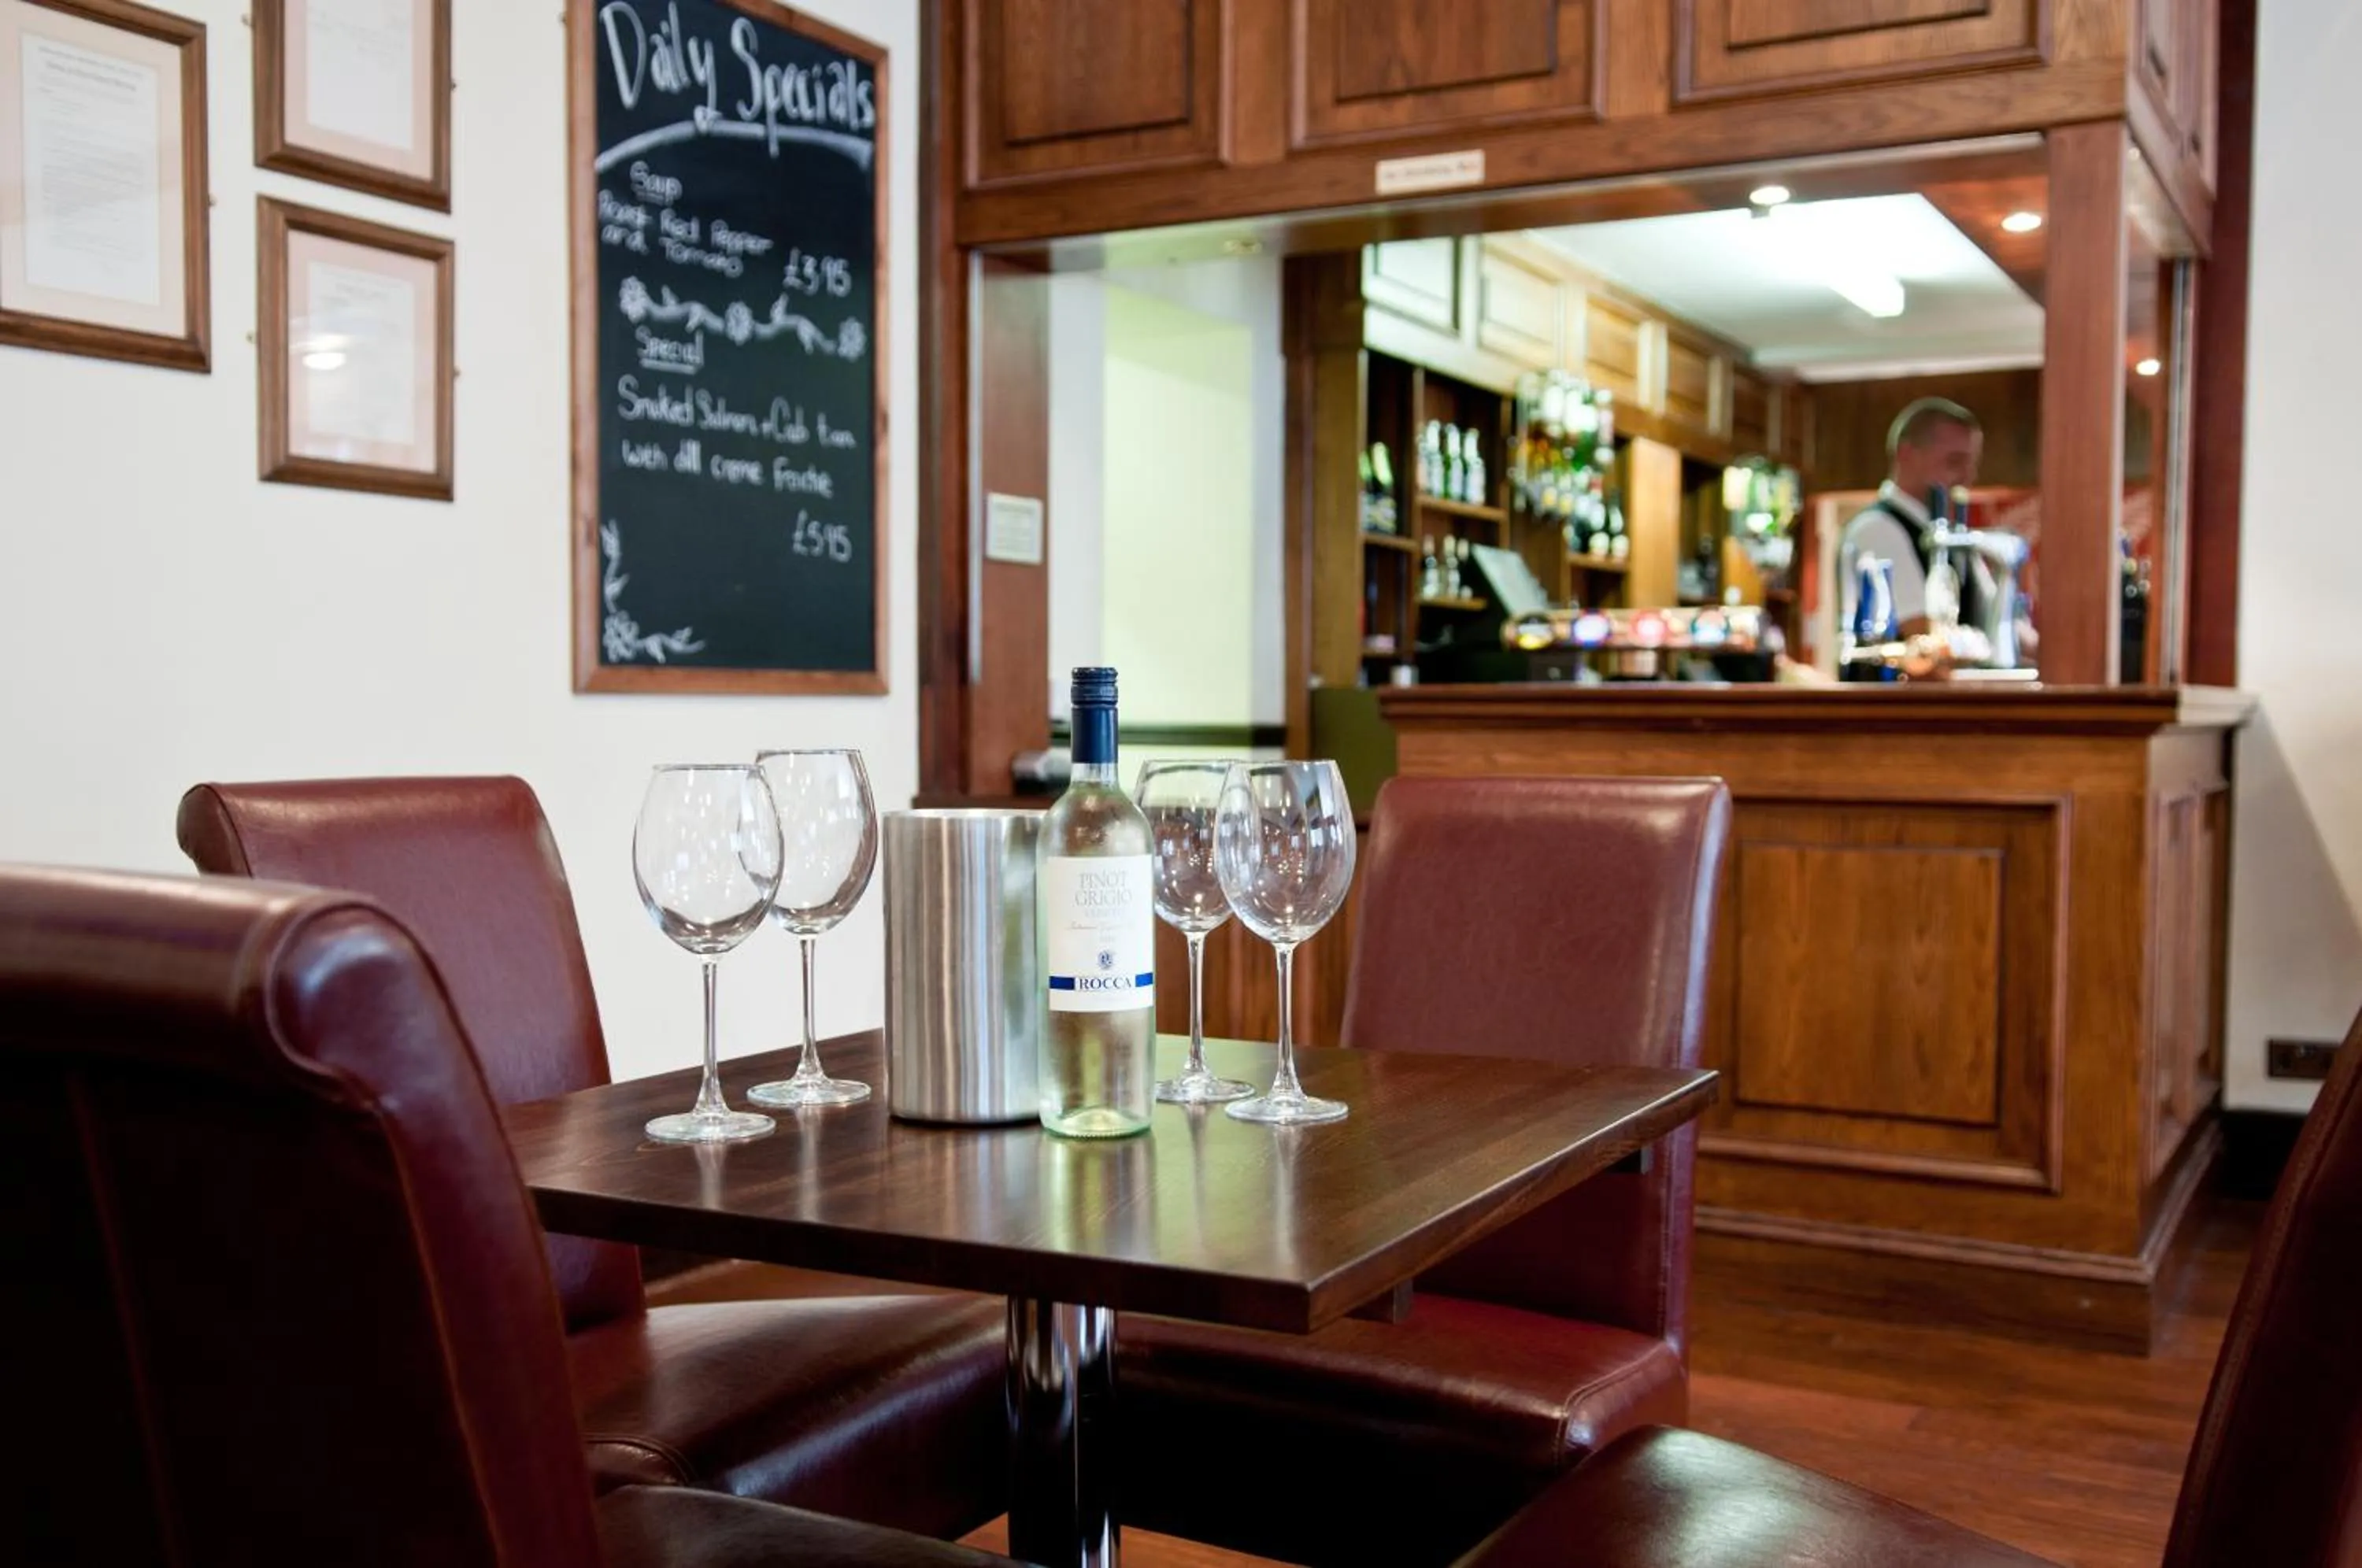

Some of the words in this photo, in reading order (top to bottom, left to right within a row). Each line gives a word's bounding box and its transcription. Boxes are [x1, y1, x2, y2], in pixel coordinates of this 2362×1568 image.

[600, 1, 723, 132] Daily
[731, 17, 875, 157] Specials
[630, 161, 683, 205] Soup
[1079, 869, 1127, 889] PINOT
[1074, 889, 1133, 907] GRIGIO
[1079, 976, 1132, 990] ROCCA
